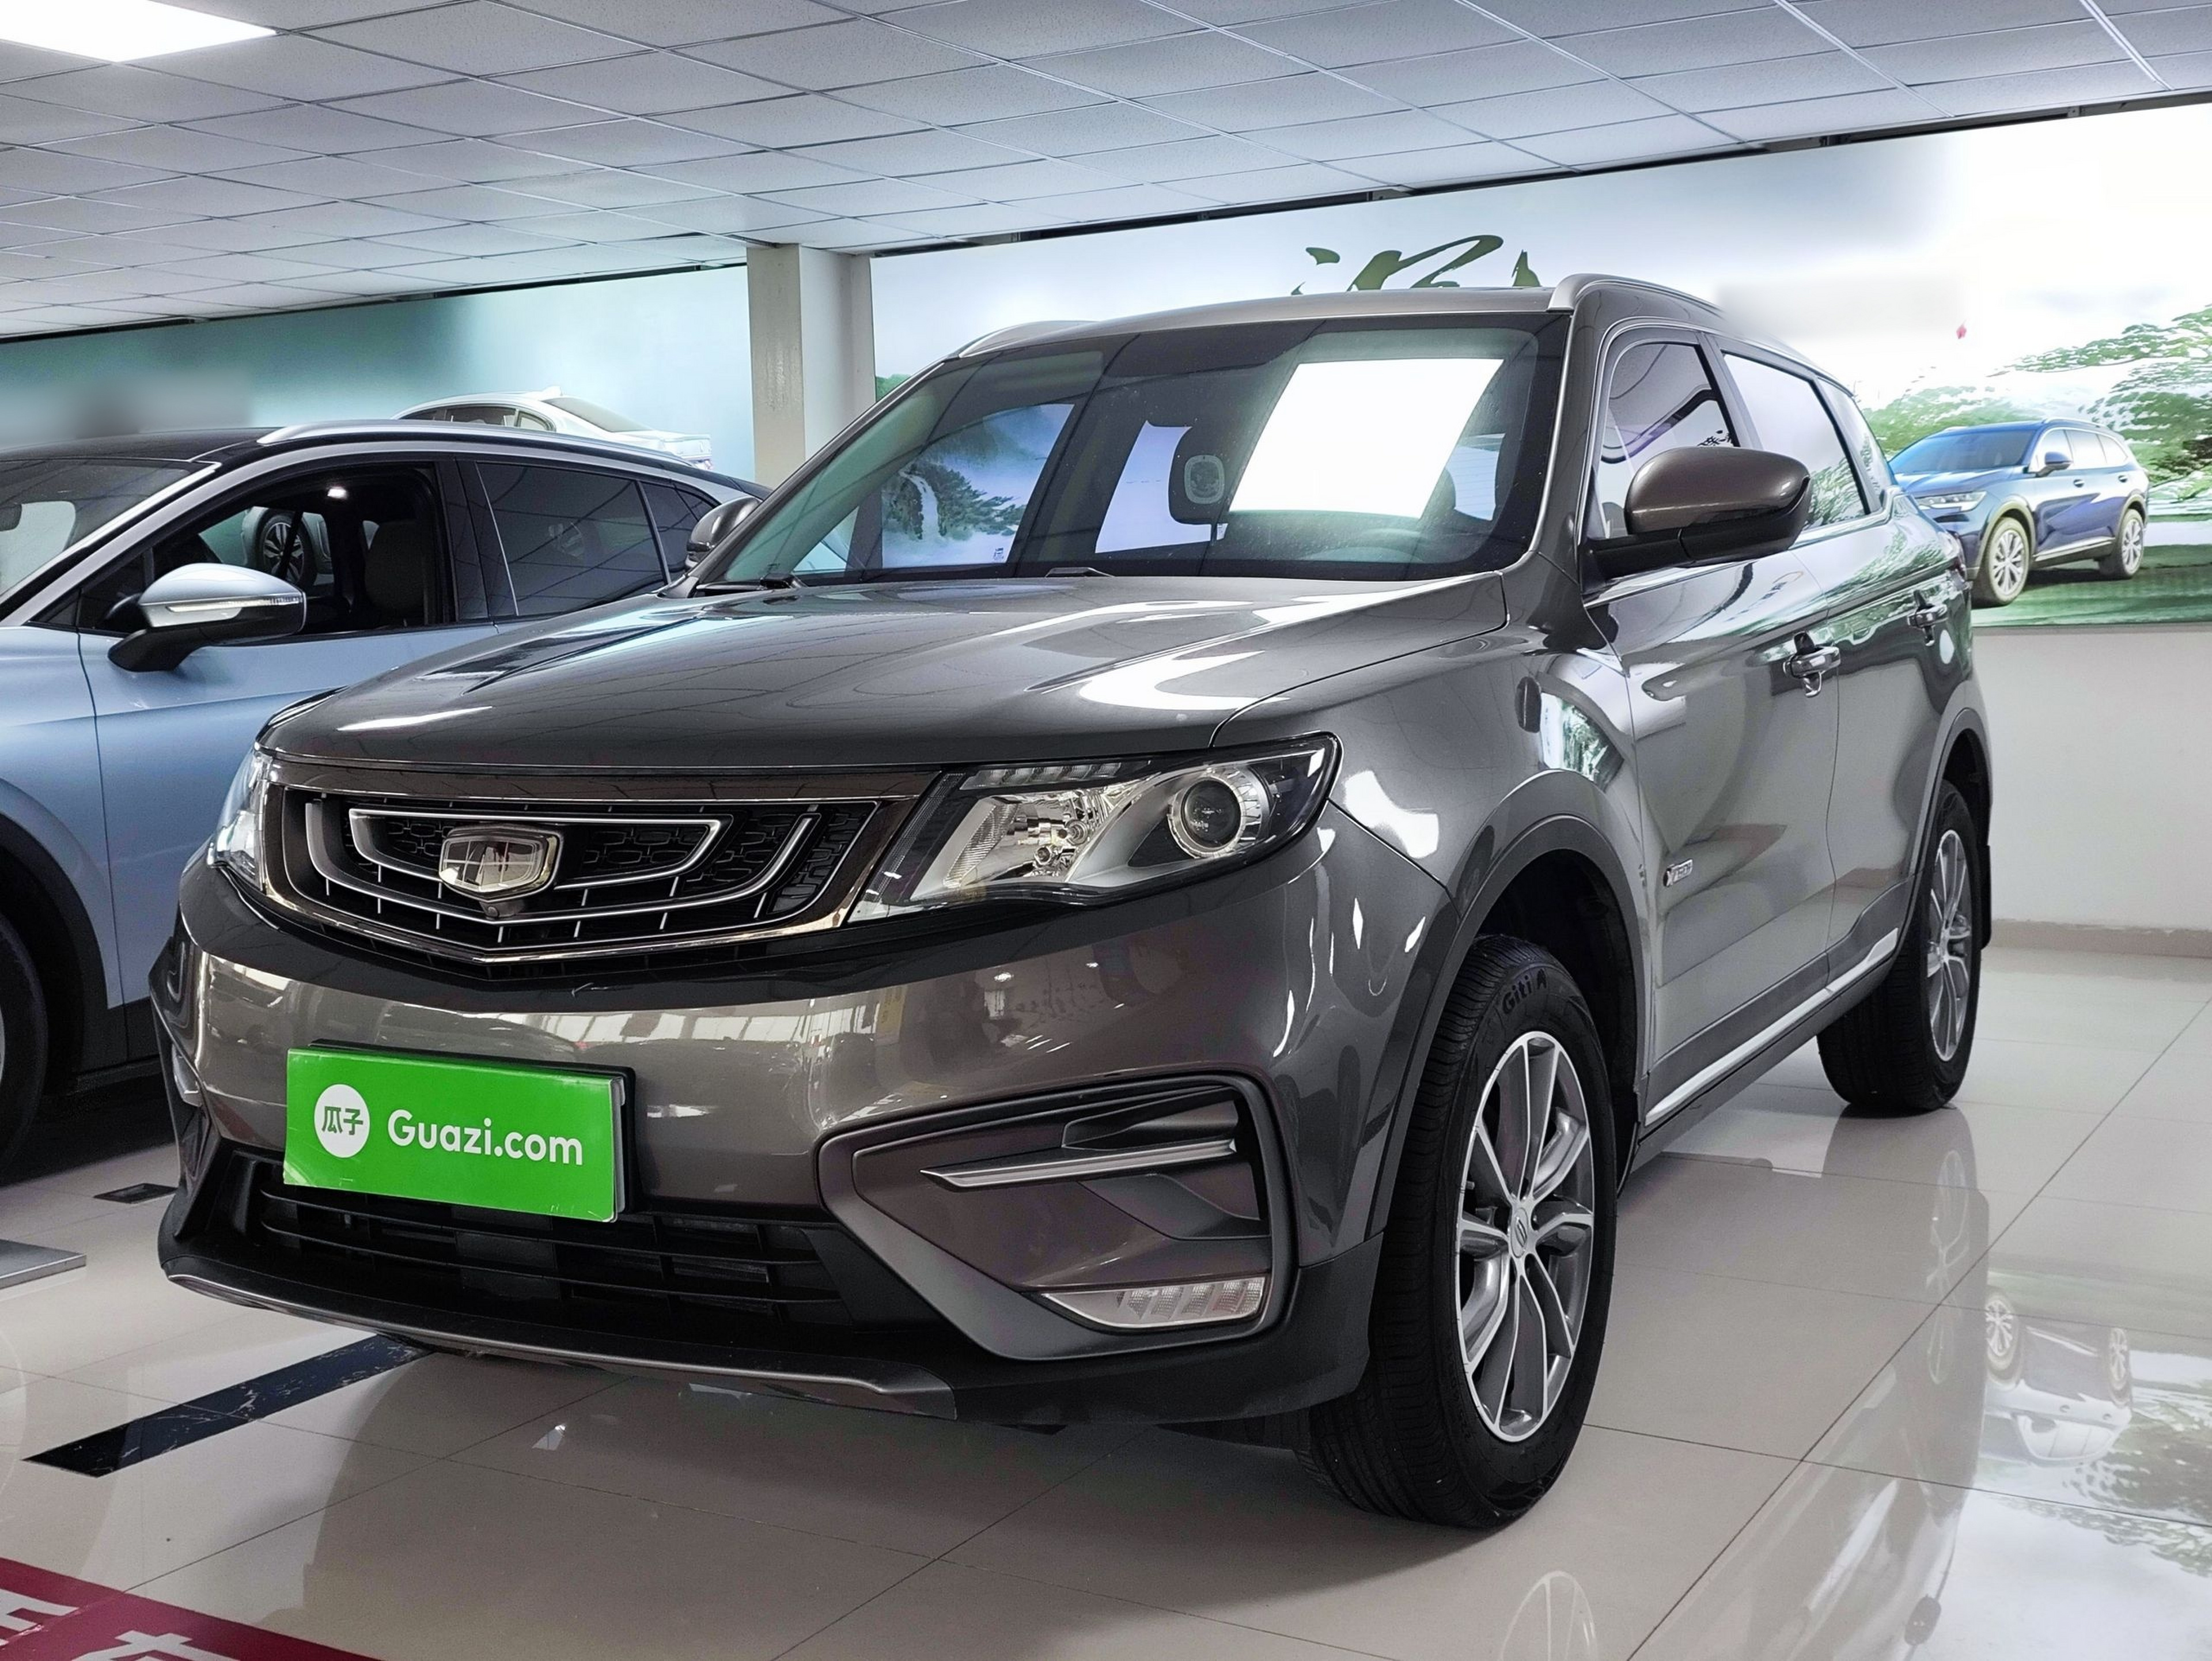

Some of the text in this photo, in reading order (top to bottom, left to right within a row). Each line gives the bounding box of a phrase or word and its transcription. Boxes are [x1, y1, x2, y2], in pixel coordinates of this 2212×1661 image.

[1502, 975, 1532, 1015] Giti
[321, 1106, 364, 1136] 瓜子
[387, 1109, 583, 1166] Guazi.com
